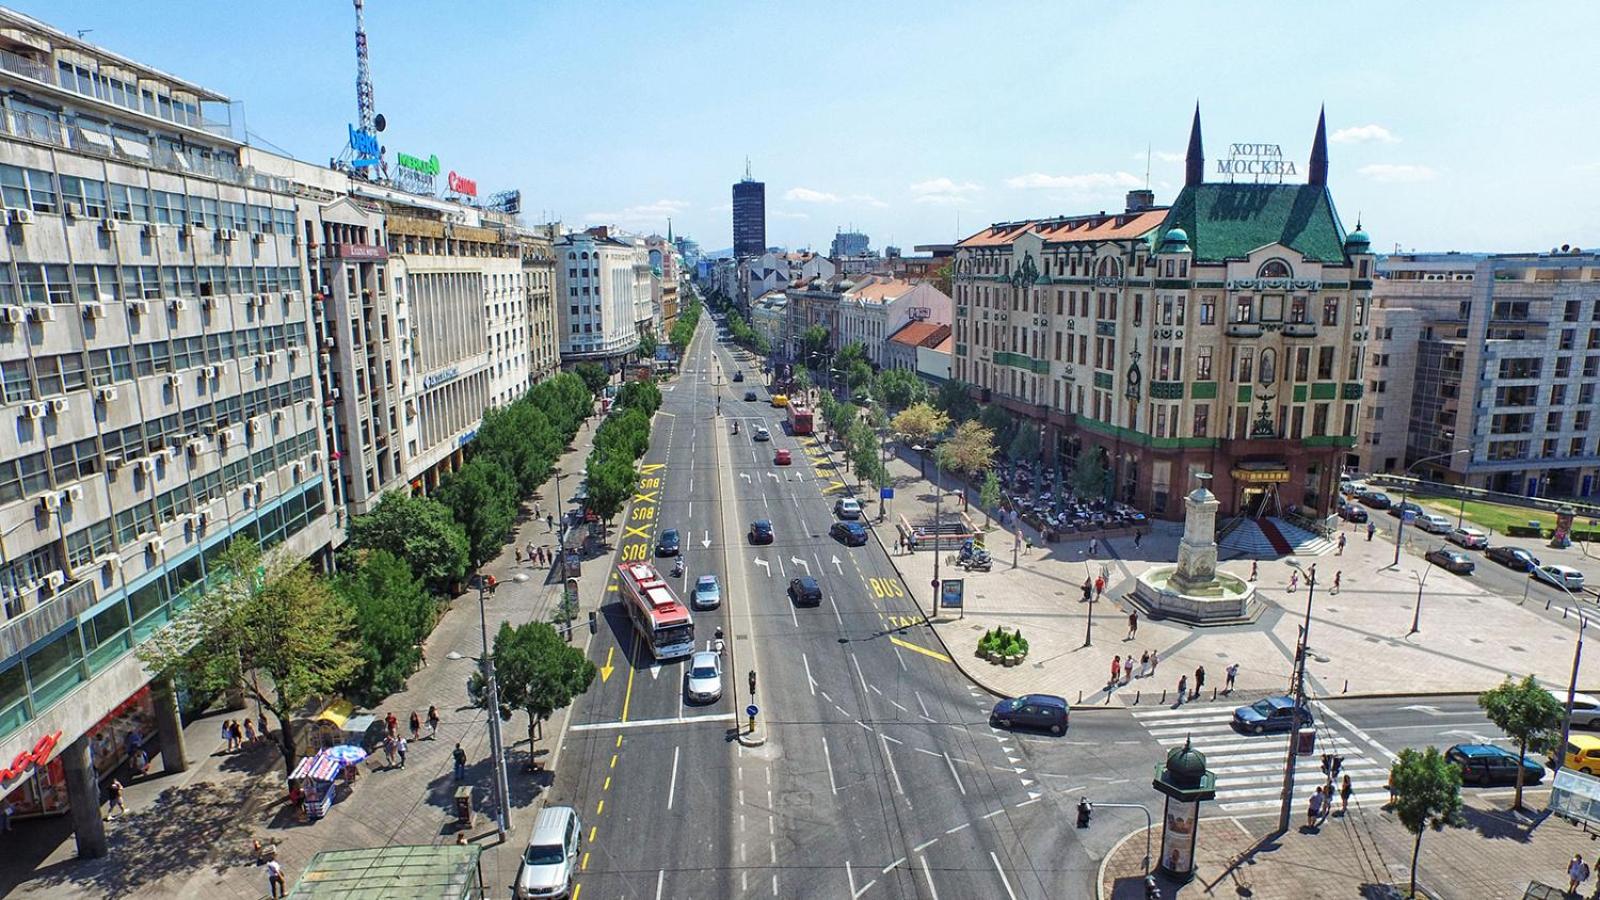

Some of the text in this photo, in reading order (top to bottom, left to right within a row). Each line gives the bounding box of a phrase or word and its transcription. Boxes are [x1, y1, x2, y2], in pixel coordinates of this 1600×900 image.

[1232, 143, 1282, 156] ХОТЕЛ
[1217, 159, 1297, 175] МОСКВА
[640, 478, 660, 489] BUS
[632, 507, 654, 519] BUS
[622, 543, 647, 560] BUS
[869, 578, 903, 597] BUS
